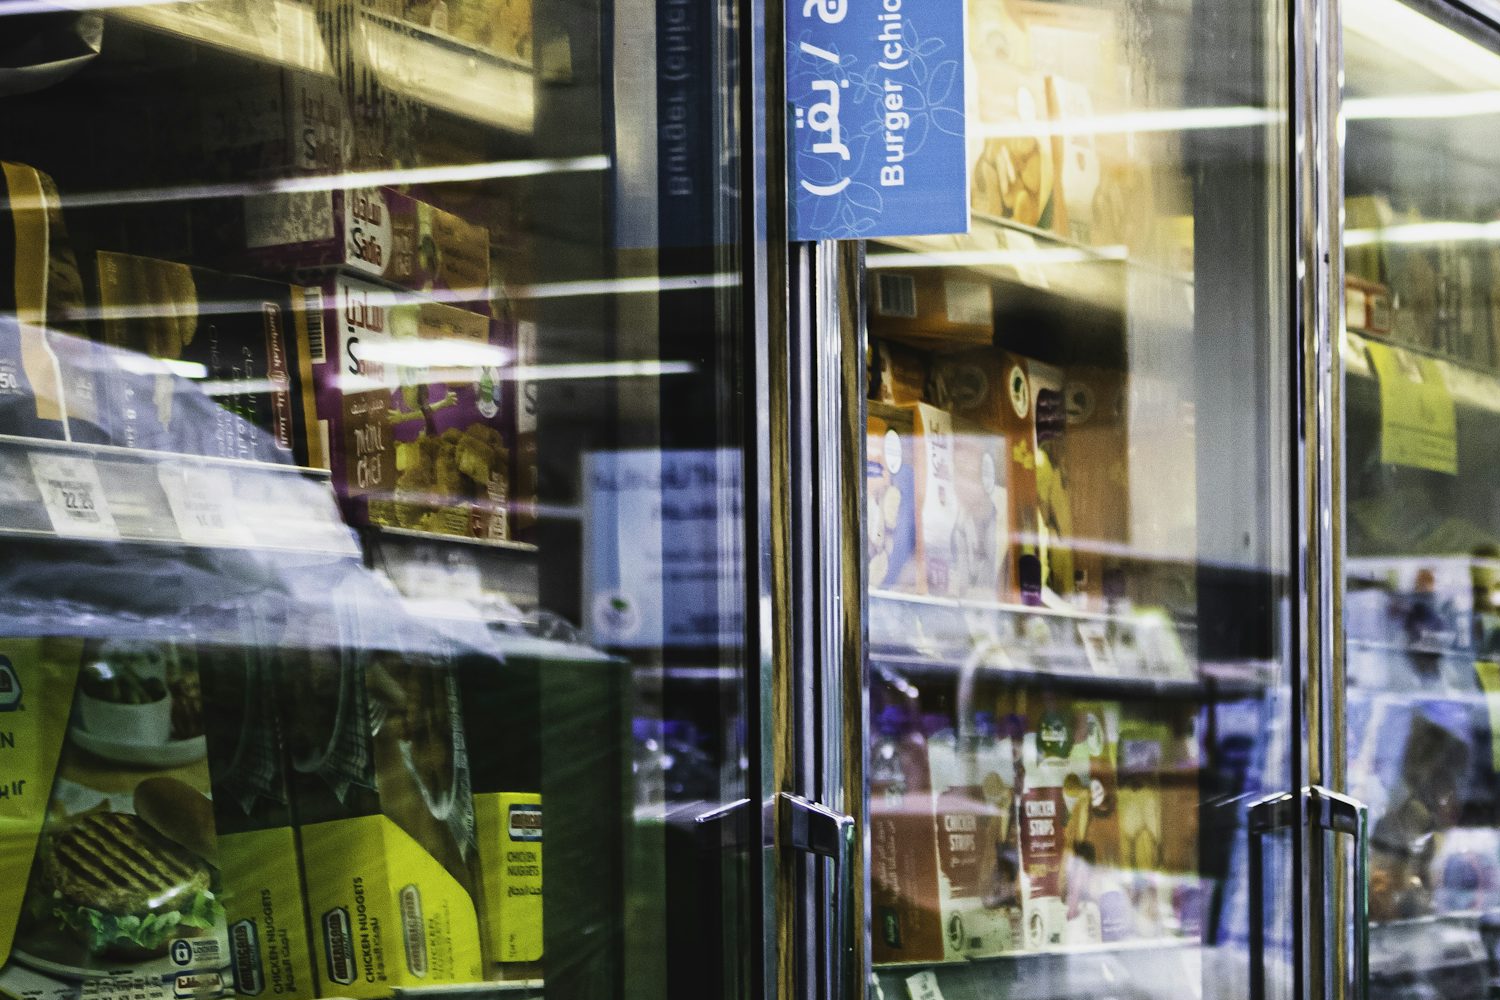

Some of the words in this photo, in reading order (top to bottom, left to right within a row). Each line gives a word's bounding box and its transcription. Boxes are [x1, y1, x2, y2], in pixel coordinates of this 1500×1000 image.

[796, 80, 851, 160] بقر
[880, 78, 910, 186] Burger
[1026, 801, 1056, 817] CHICKEN
[1029, 819, 1056, 836] STRIPS
[260, 888, 276, 944] NUGGETS
[352, 877, 369, 932] NUGGETS
[267, 944, 283, 994] CHICKEN
[359, 933, 376, 983] CHICKEN
